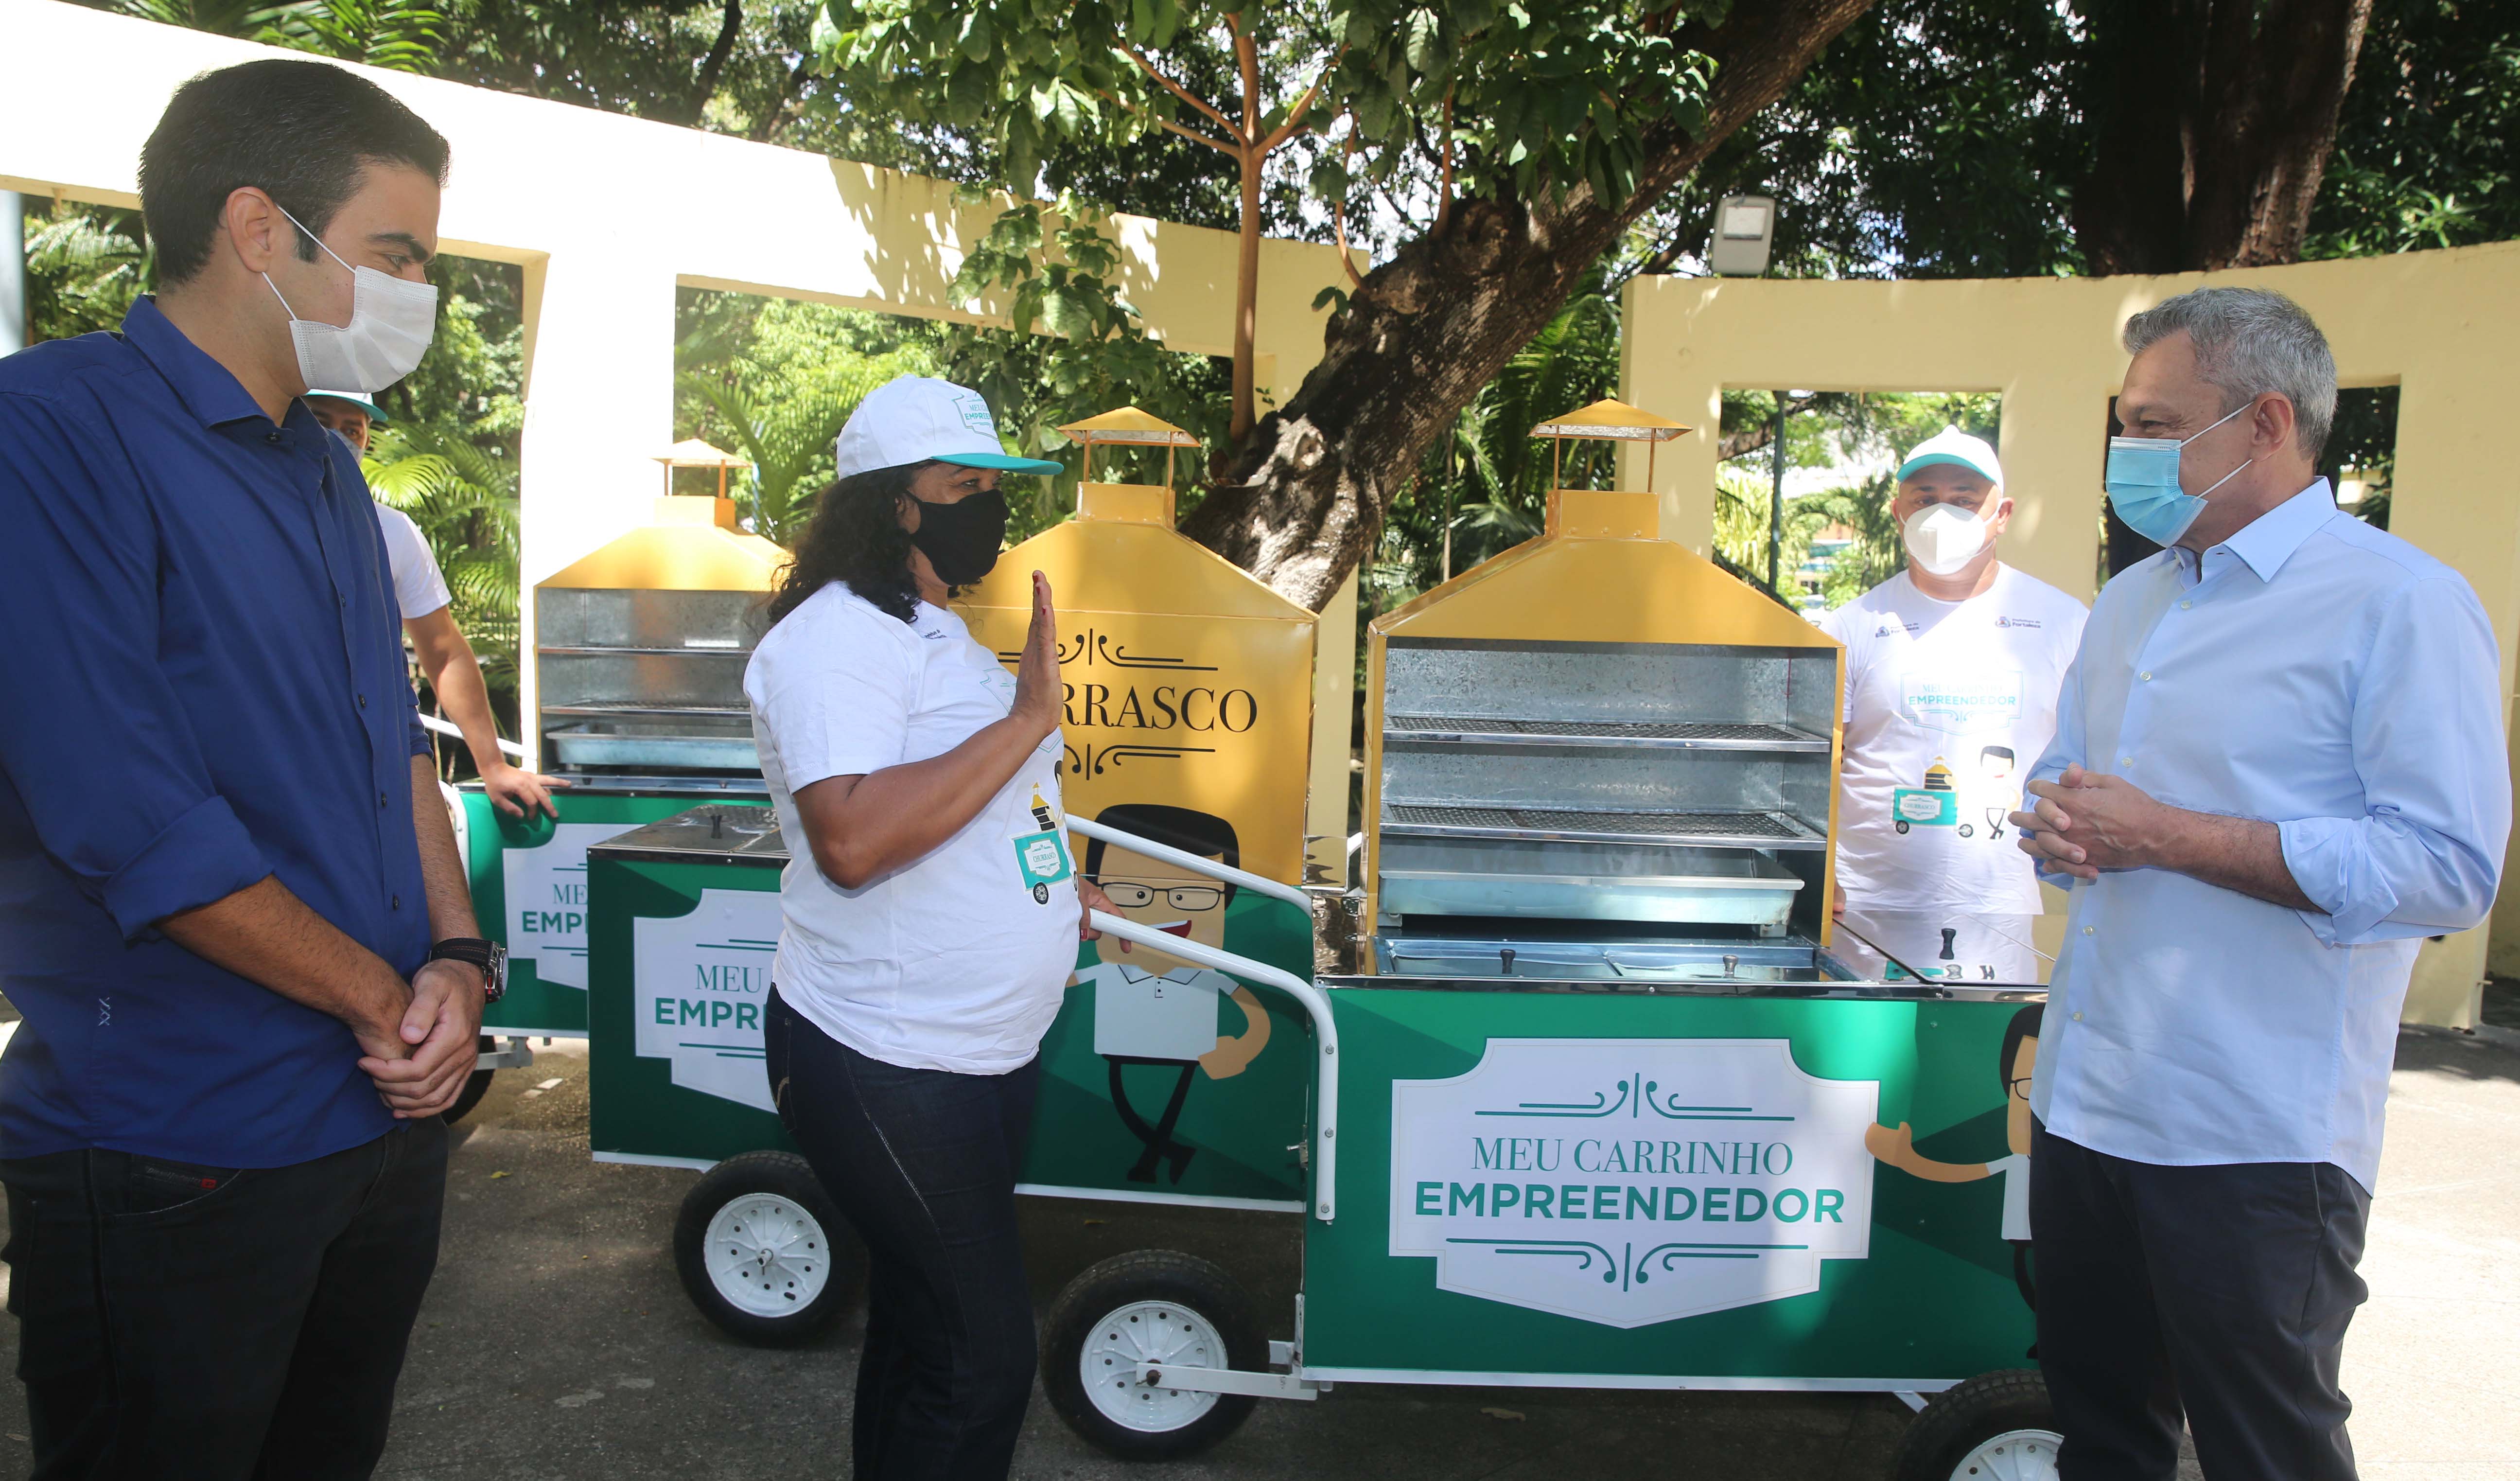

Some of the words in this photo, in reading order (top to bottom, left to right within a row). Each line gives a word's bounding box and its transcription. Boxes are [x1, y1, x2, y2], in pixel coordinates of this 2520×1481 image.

[1908, 695, 2016, 705] EMPREENDEDOR
[522, 911, 589, 934] EMP
[695, 964, 763, 993] MEU
[656, 998, 767, 1030] EMPR
[1470, 1137, 1564, 1171] MEU
[1574, 1139, 1793, 1175] CARRINHO
[1416, 1181, 1844, 1223] EMPREENDEDOR
